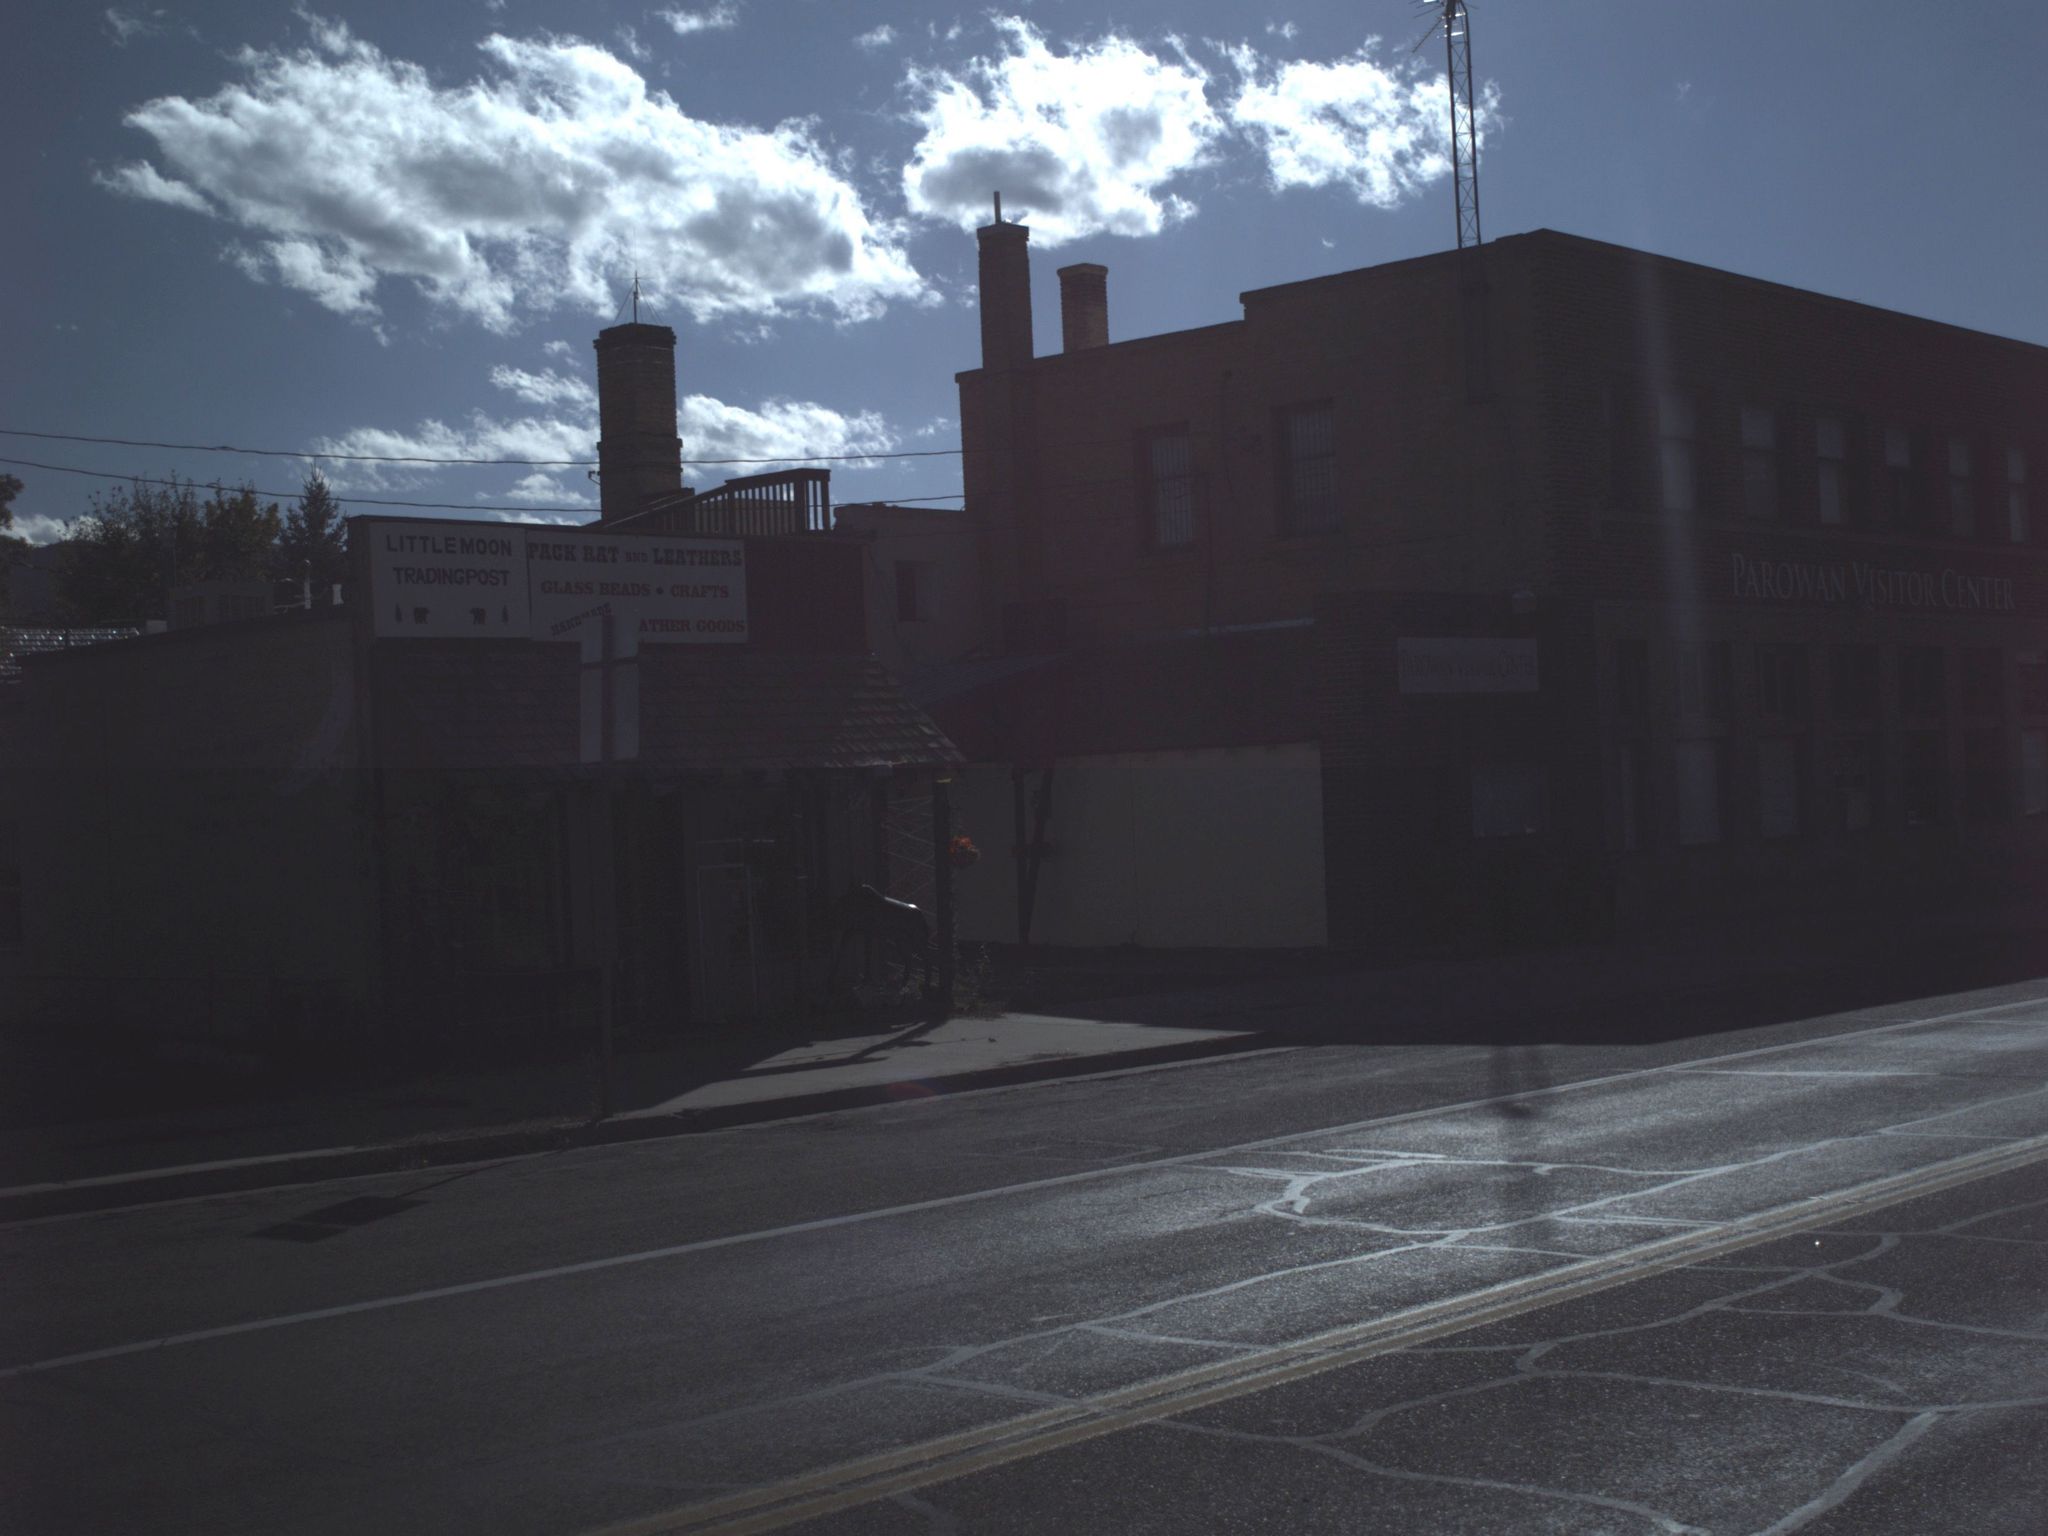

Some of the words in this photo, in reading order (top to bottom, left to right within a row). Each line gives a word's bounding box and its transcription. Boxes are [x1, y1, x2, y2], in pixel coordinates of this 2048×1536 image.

[527, 542, 577, 562] PACK
[583, 545, 620, 564] RAT
[652, 547, 743, 567] LEATHERS
[540, 580, 594, 595] GLASS
[599, 582, 651, 597] BEADS
[670, 584, 729, 598] CRAFTS
[1731, 551, 1847, 602] PAROWAN
[1852, 560, 1937, 607] VISITOR
[1941, 567, 2016, 611] CENTER
[638, 618, 691, 633] ATHER
[696, 619, 745, 633] GOODS
